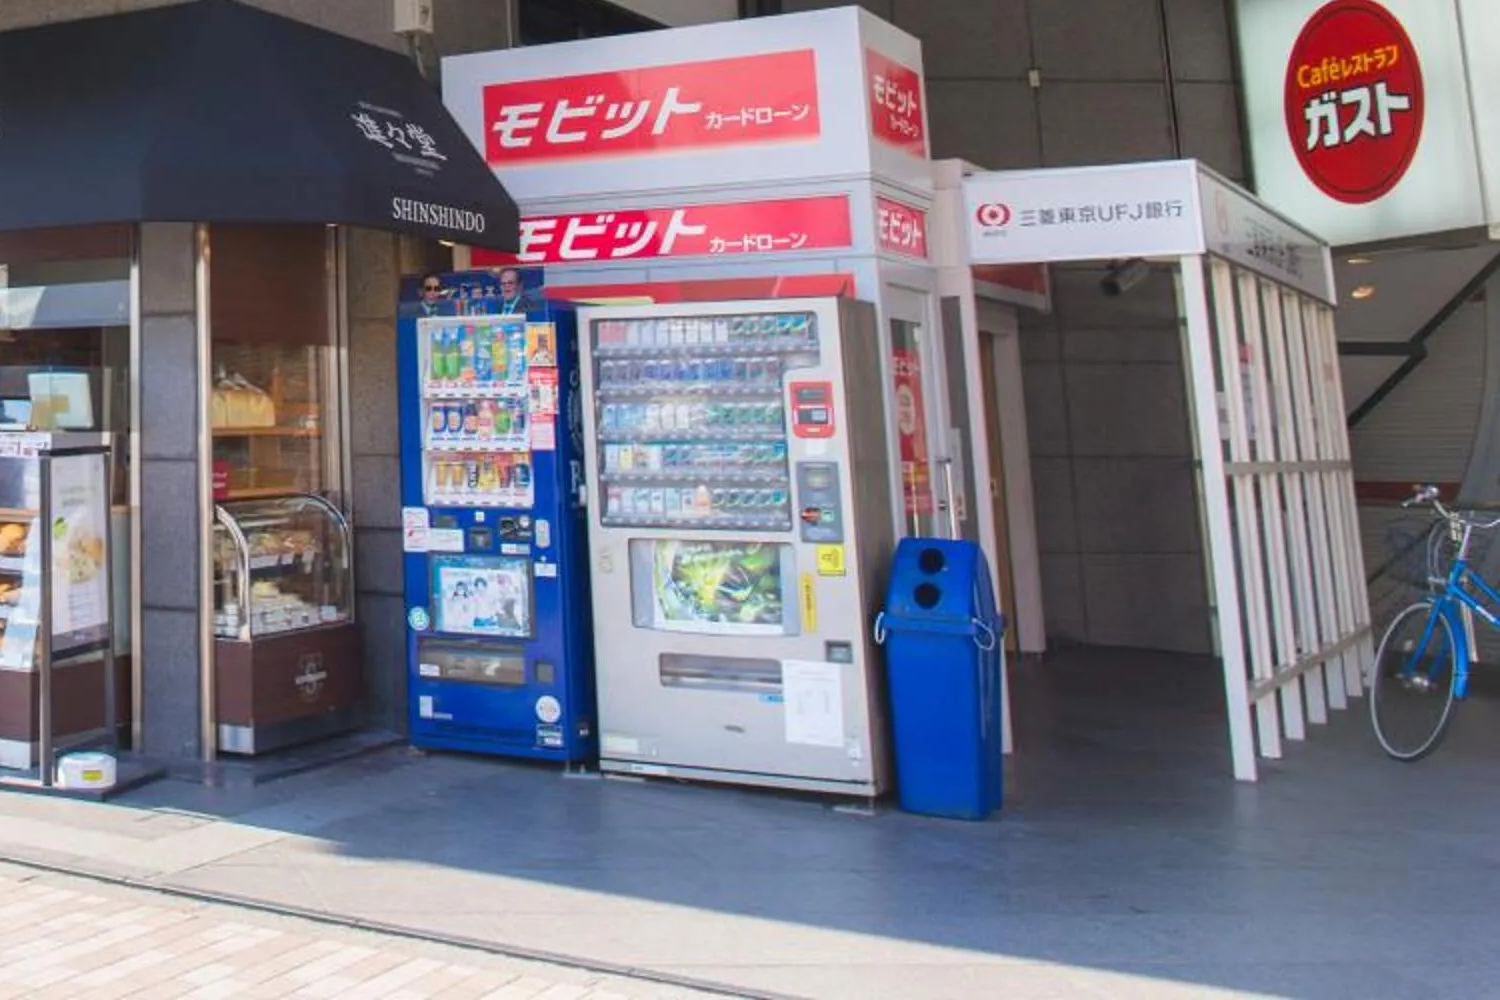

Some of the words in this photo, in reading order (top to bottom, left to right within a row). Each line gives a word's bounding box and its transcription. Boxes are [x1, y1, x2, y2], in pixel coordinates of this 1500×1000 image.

[492, 87, 702, 147] モビット
[705, 103, 810, 130] カードローン
[873, 74, 917, 118] モビット
[1304, 81, 1410, 151] ガスト
[392, 197, 485, 233] SHINSHINDO
[516, 209, 706, 261] モビット
[710, 232, 808, 253] カードローン
[878, 209, 922, 249] モビット
[1020, 200, 1183, 227] 三菱東京UFJ銀行
